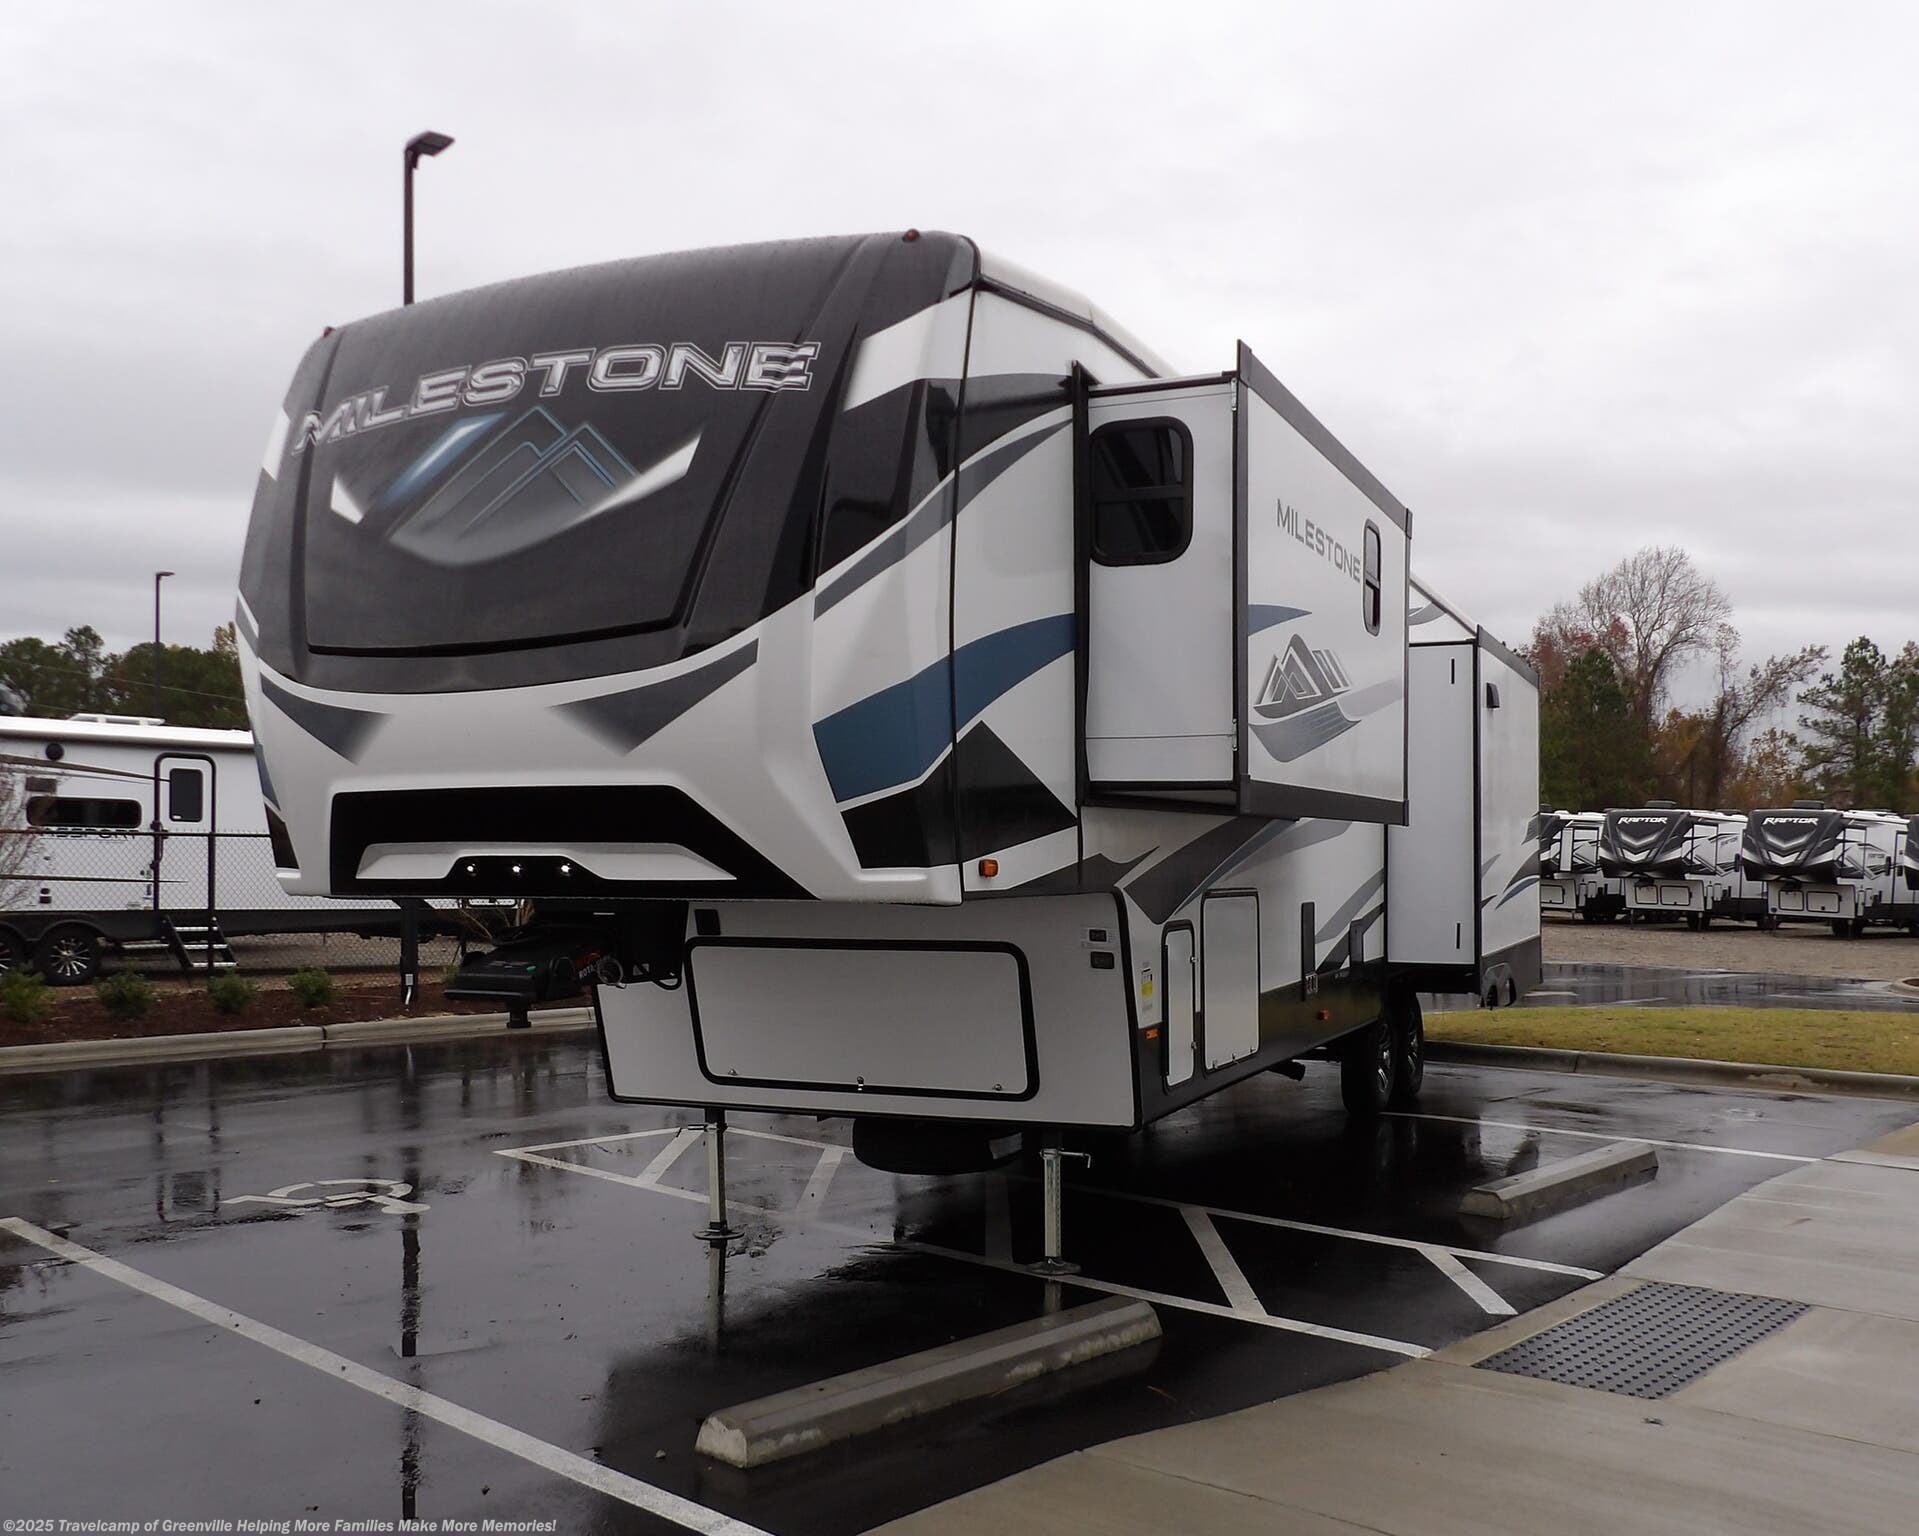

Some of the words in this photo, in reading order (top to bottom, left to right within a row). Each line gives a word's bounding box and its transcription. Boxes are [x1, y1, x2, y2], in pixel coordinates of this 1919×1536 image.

[292, 340, 822, 454] MILESTONE
[1276, 498, 1361, 583] MILESTONE
[1617, 816, 1669, 825] RAPTOR
[1761, 816, 1820, 827] RAPTOR
